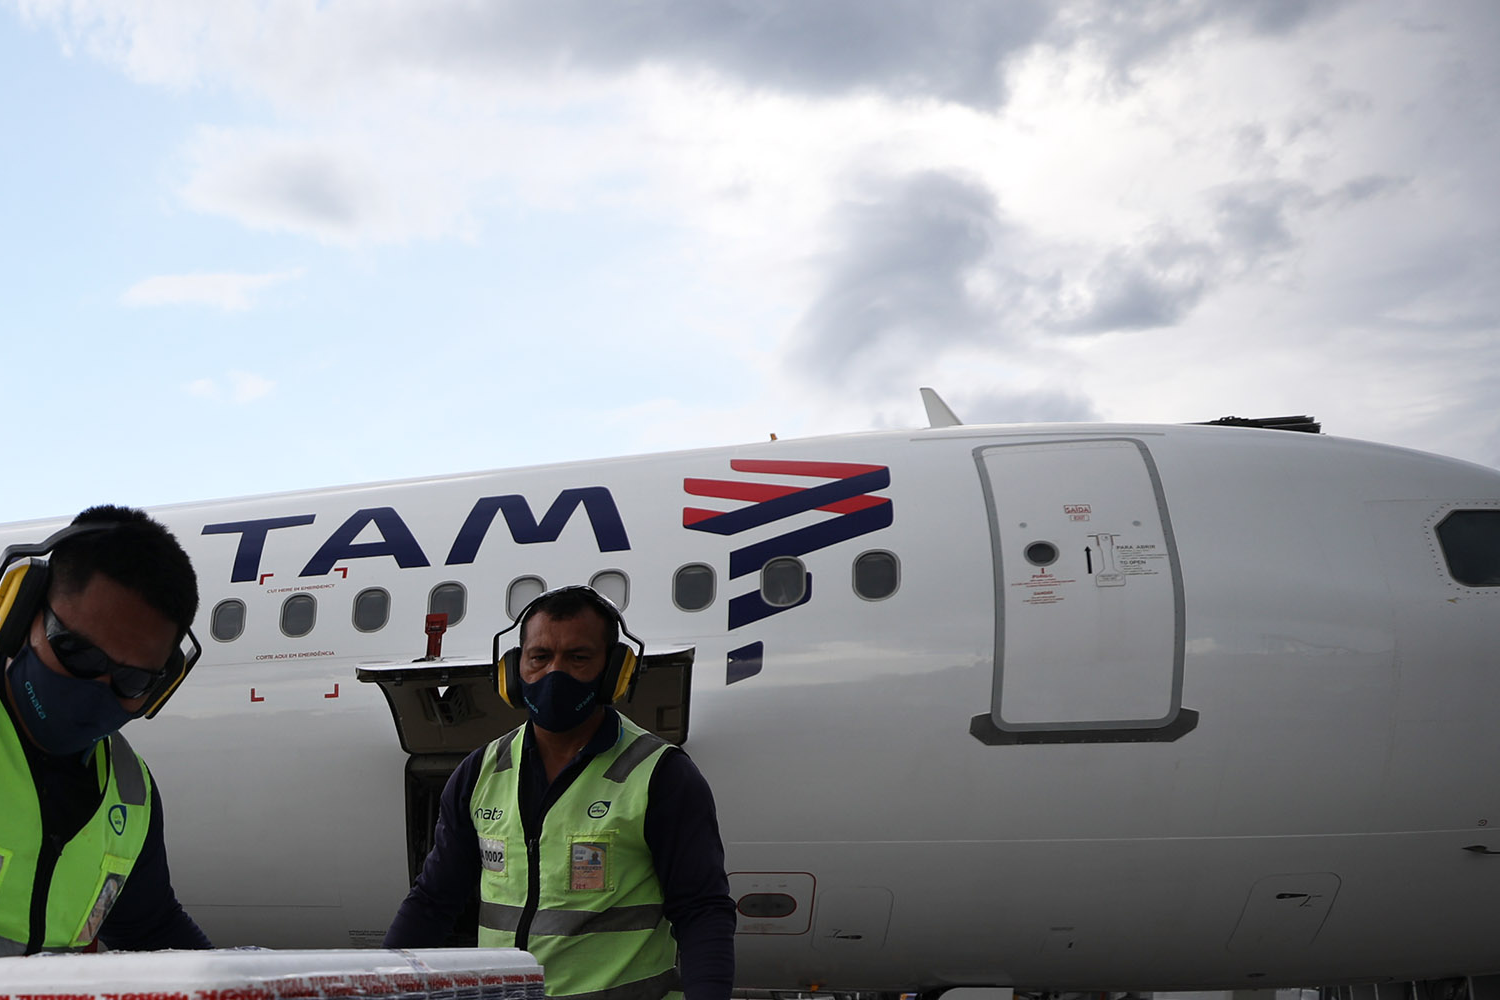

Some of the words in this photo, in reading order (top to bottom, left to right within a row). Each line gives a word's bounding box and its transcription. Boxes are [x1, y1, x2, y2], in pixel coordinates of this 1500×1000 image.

[201, 486, 631, 582] TAM
[301, 583, 336, 591] EMERGENCY
[298, 650, 335, 658] EMERGÊNCIA
[25, 681, 46, 720] dnata
[474, 807, 504, 821] nata
